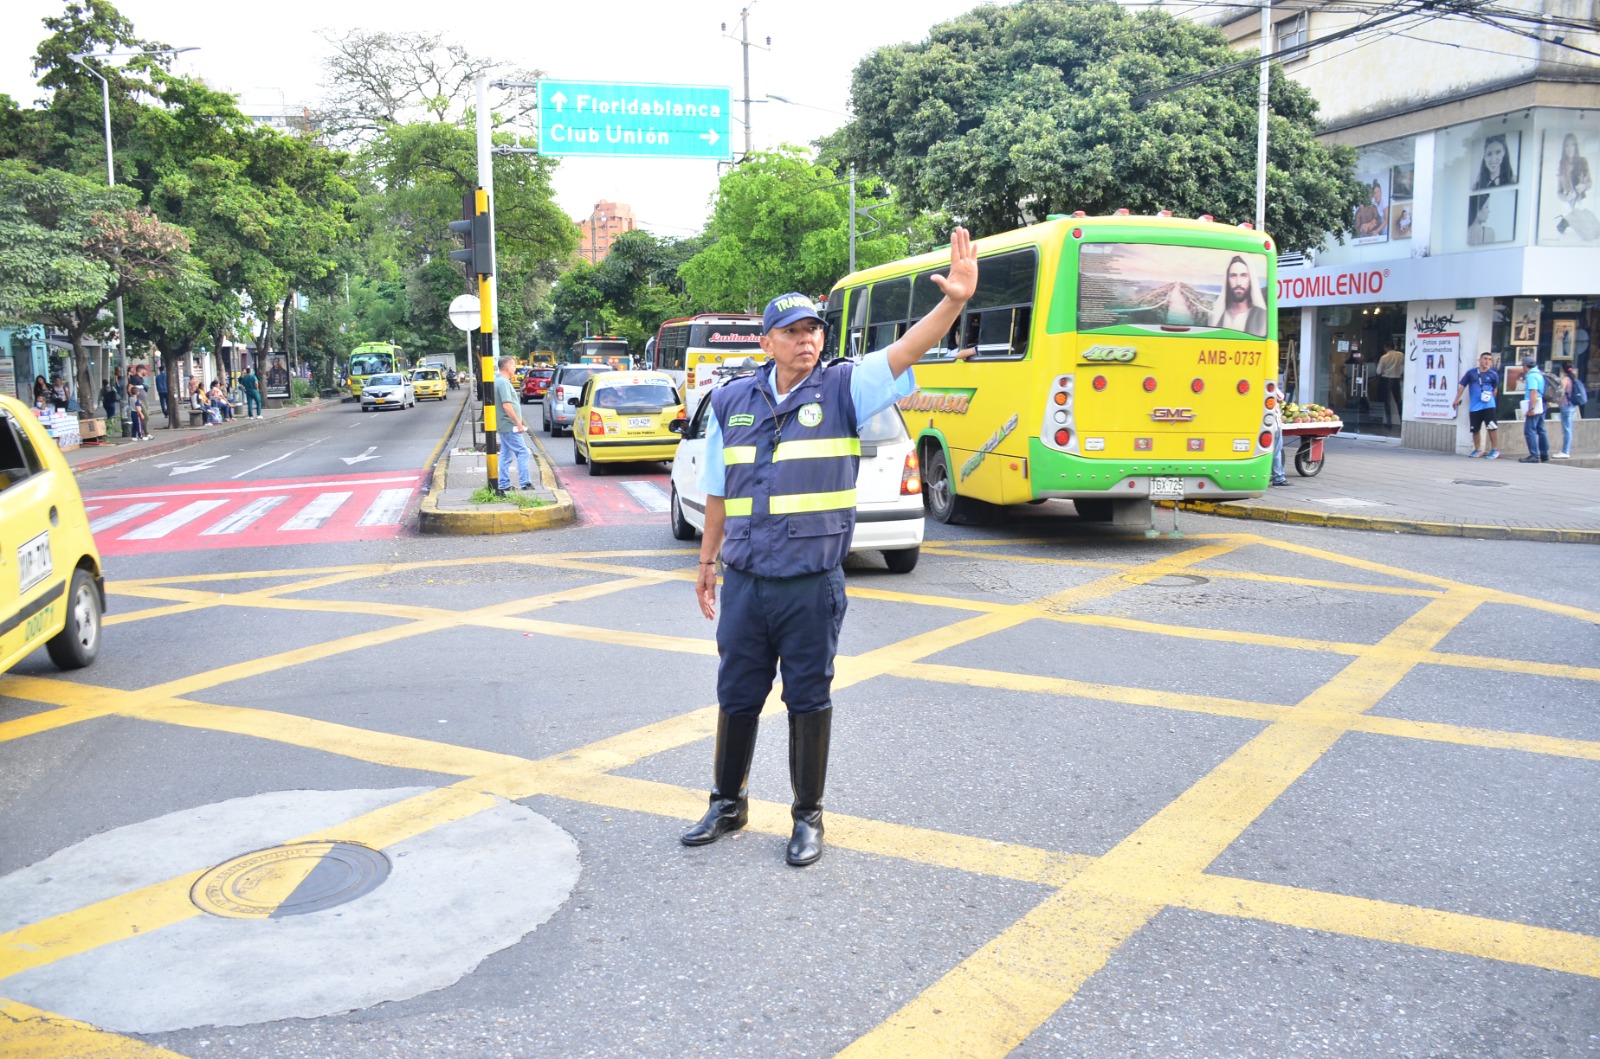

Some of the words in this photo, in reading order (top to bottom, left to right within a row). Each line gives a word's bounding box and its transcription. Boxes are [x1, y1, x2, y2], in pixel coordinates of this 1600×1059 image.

[576, 95, 721, 118] Floridablanca
[550, 123, 599, 143] Club
[606, 124, 669, 145] Unión
[1082, 346, 1137, 362] 406
[1197, 350, 1262, 366] AMB-0737
[1153, 408, 1192, 418] GMC
